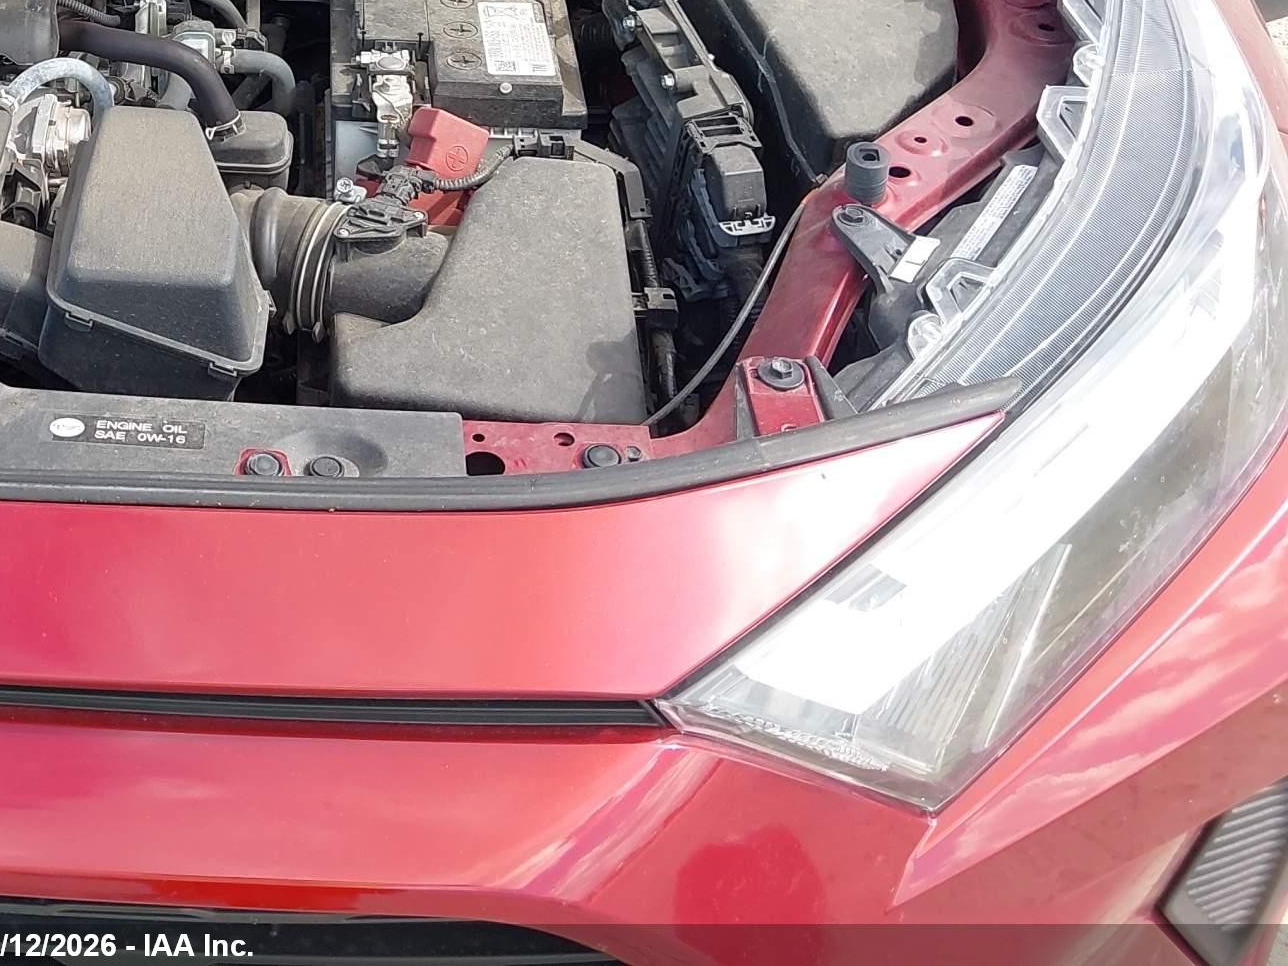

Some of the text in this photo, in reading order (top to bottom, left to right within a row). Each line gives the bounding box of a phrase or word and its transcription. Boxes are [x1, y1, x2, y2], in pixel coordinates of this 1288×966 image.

[96, 420, 153, 432] ENGINE
[162, 424, 188, 434] OIL
[94, 430, 186, 444] SAE 0W-16
